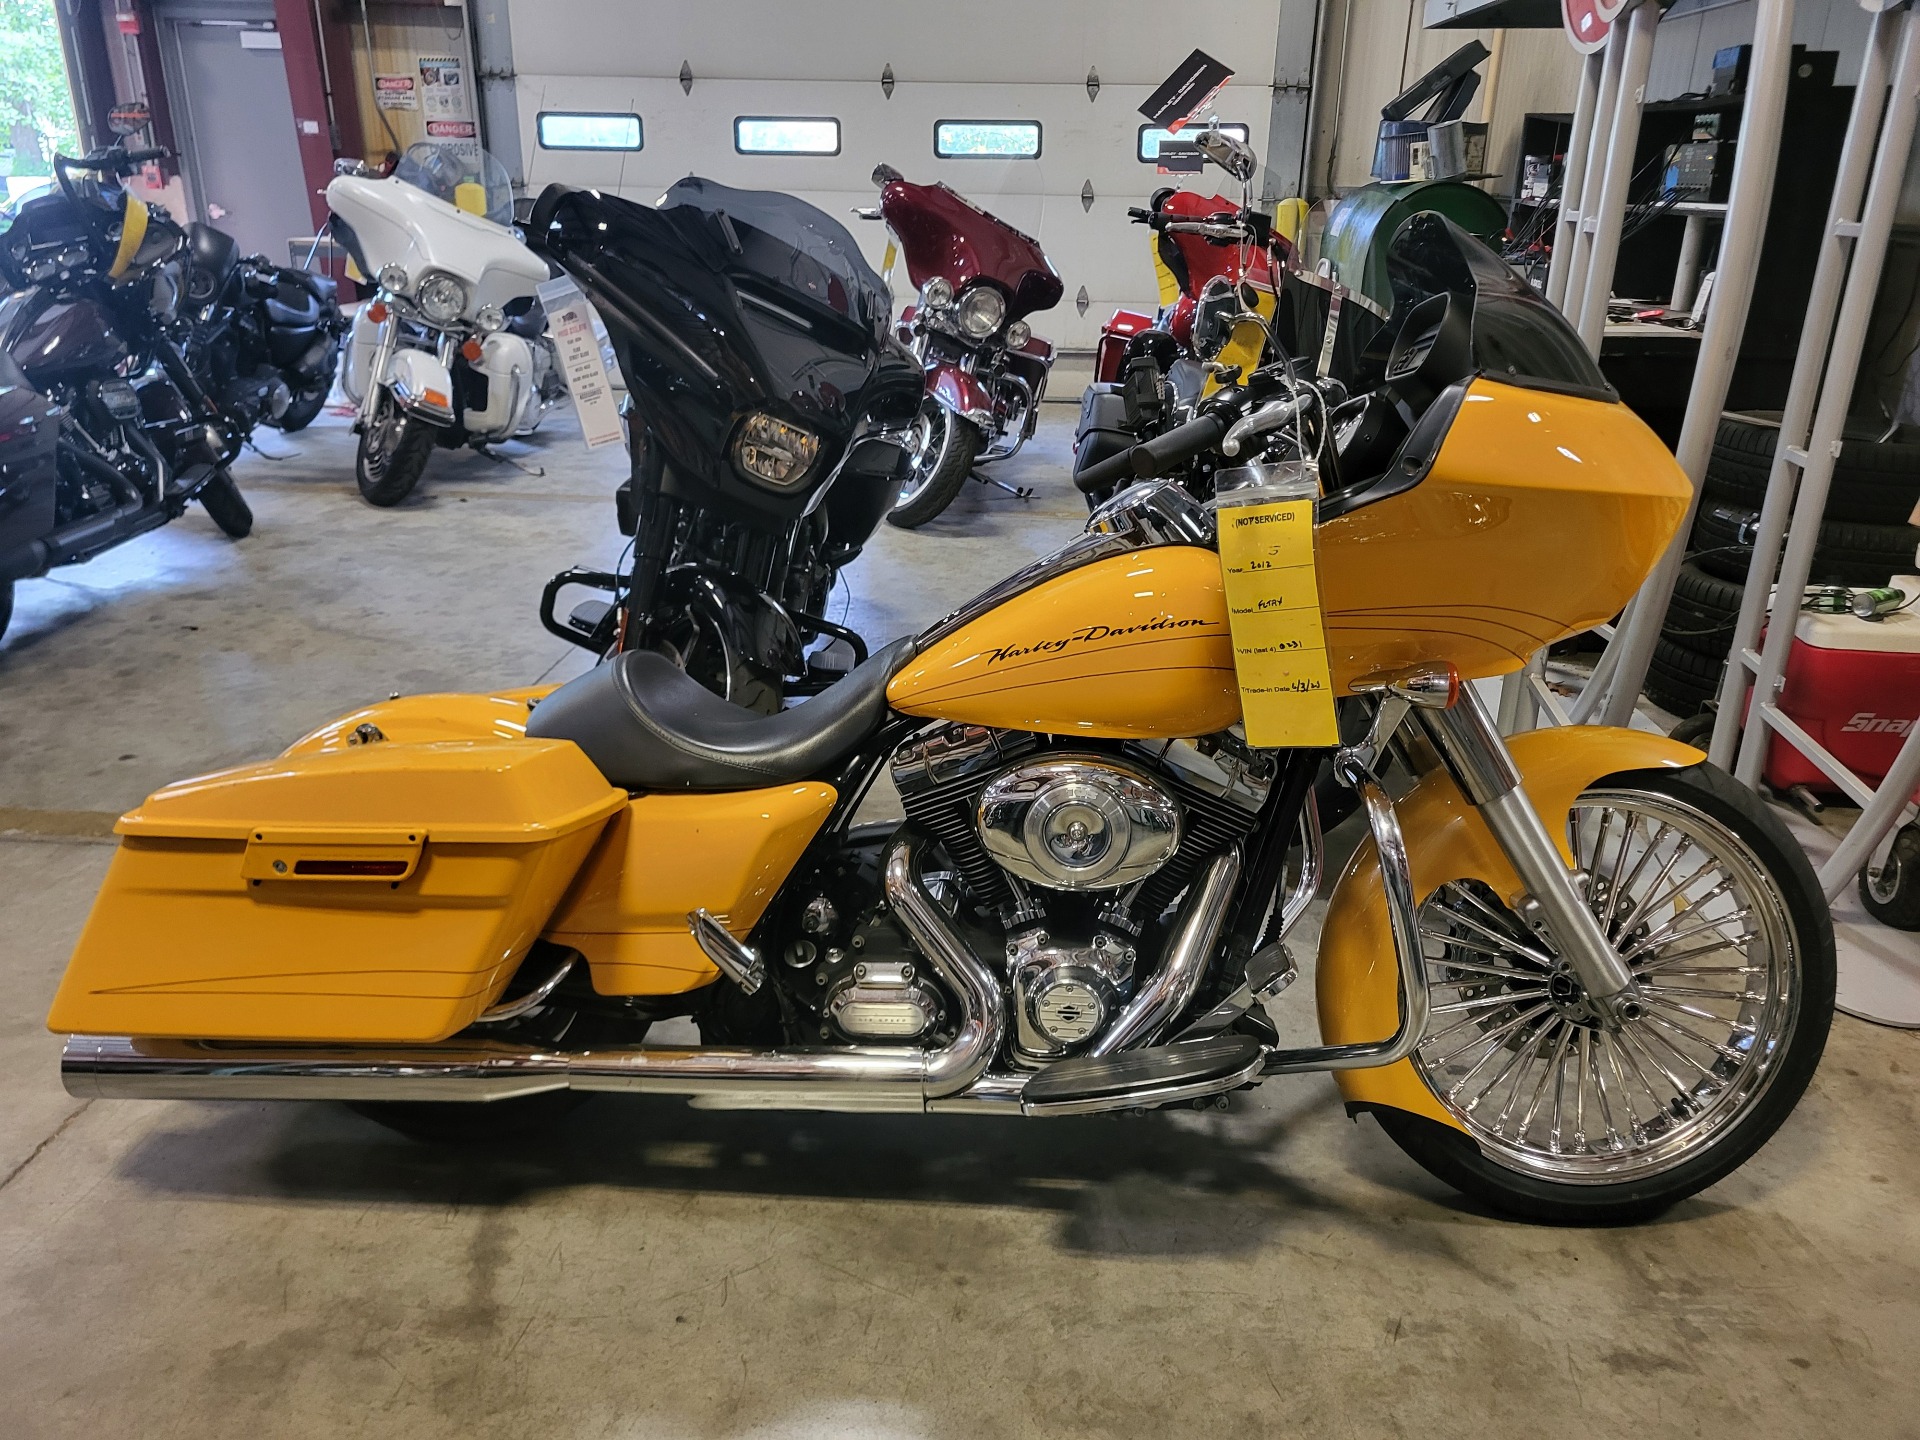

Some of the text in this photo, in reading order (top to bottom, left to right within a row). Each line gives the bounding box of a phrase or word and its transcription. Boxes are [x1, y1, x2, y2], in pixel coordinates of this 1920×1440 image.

[380, 80, 412, 89] DANGER
[432, 124, 473, 134] DANGER
[1254, 512, 1295, 525] SERVICED)
[1250, 560, 1272, 570] 2012
[983, 617, 1220, 666] Harley-Davidson
